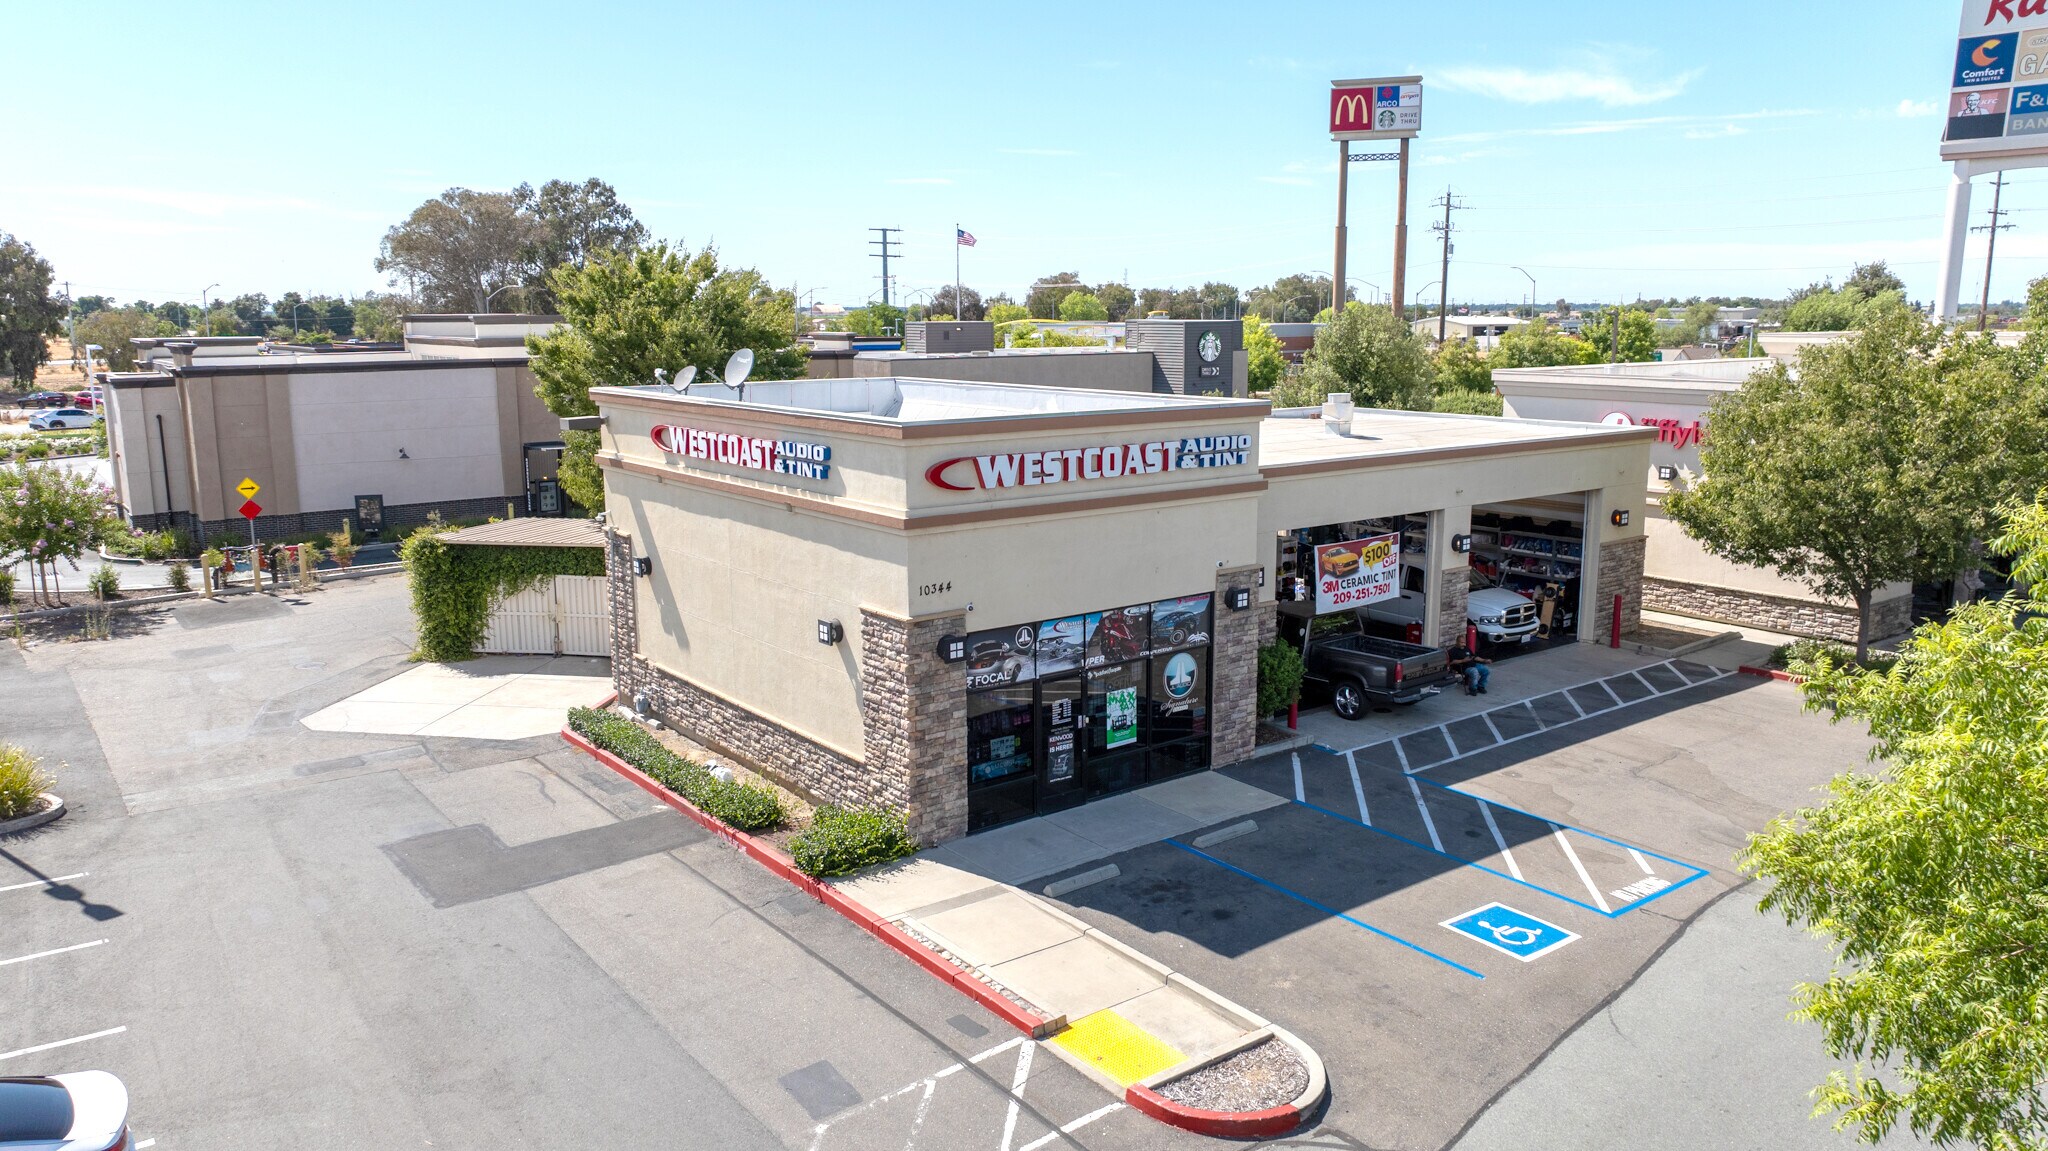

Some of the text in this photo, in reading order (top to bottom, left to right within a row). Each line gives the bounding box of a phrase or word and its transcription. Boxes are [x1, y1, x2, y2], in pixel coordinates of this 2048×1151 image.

[1962, 67, 2004, 79] Comfort
[2016, 91, 2048, 108] F&
[668, 425, 774, 471] WESTCOAST
[774, 440, 828, 462] AUDIO
[1182, 434, 1252, 452] AUDIO
[774, 458, 828, 480] & TINT
[975, 441, 1180, 489] WESTCOAST
[1180, 451, 1250, 469] & TINT
[1365, 543, 1389, 563] $100
[1383, 554, 1396, 567] OFF
[919, 581, 952, 596] 10344
[1322, 569, 1397, 593] 3M CERAMIC TINT
[1333, 582, 1391, 604] 209-251-7501
[975, 671, 1011, 686] FOCAL
[1049, 733, 1073, 743] KENWOOD
